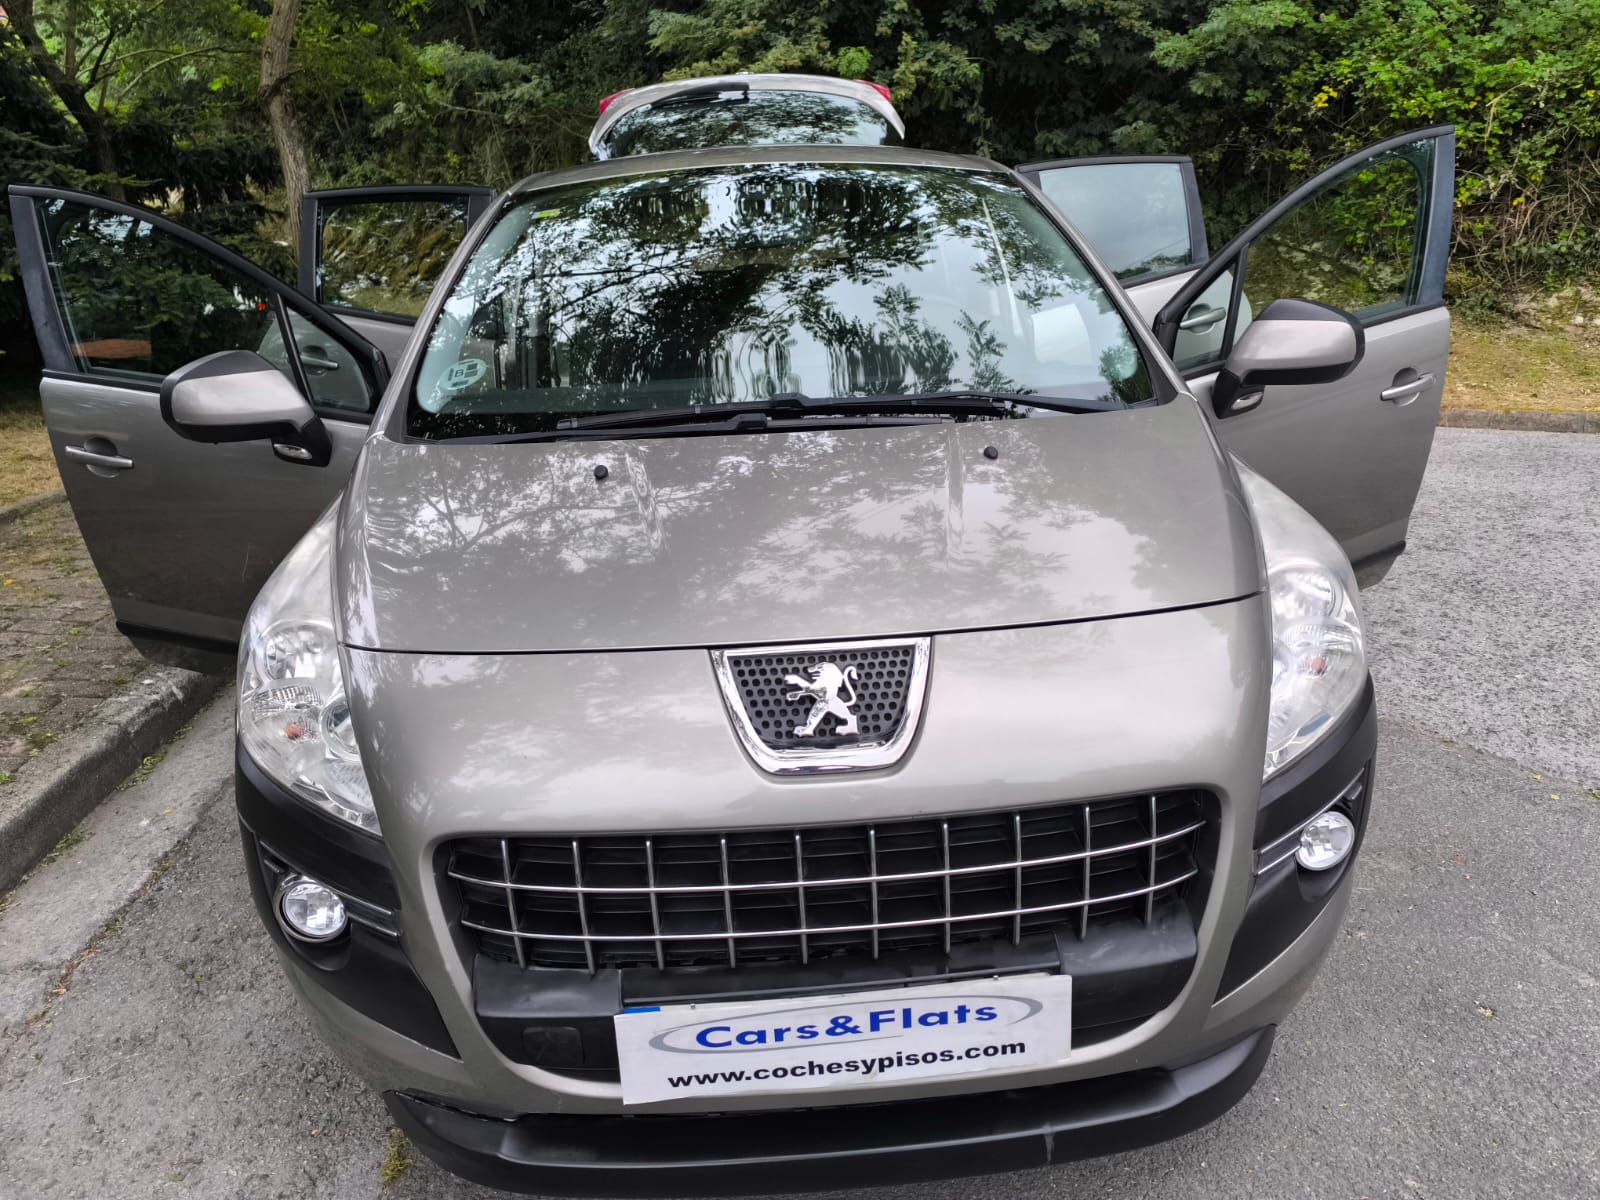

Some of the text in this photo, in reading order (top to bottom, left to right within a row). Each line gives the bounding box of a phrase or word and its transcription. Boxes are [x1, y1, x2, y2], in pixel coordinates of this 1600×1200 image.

[454, 368, 465, 378] B
[695, 1003, 998, 1049] Cars&Flats
[667, 1040, 1026, 1088] www.cochesypisos.com
